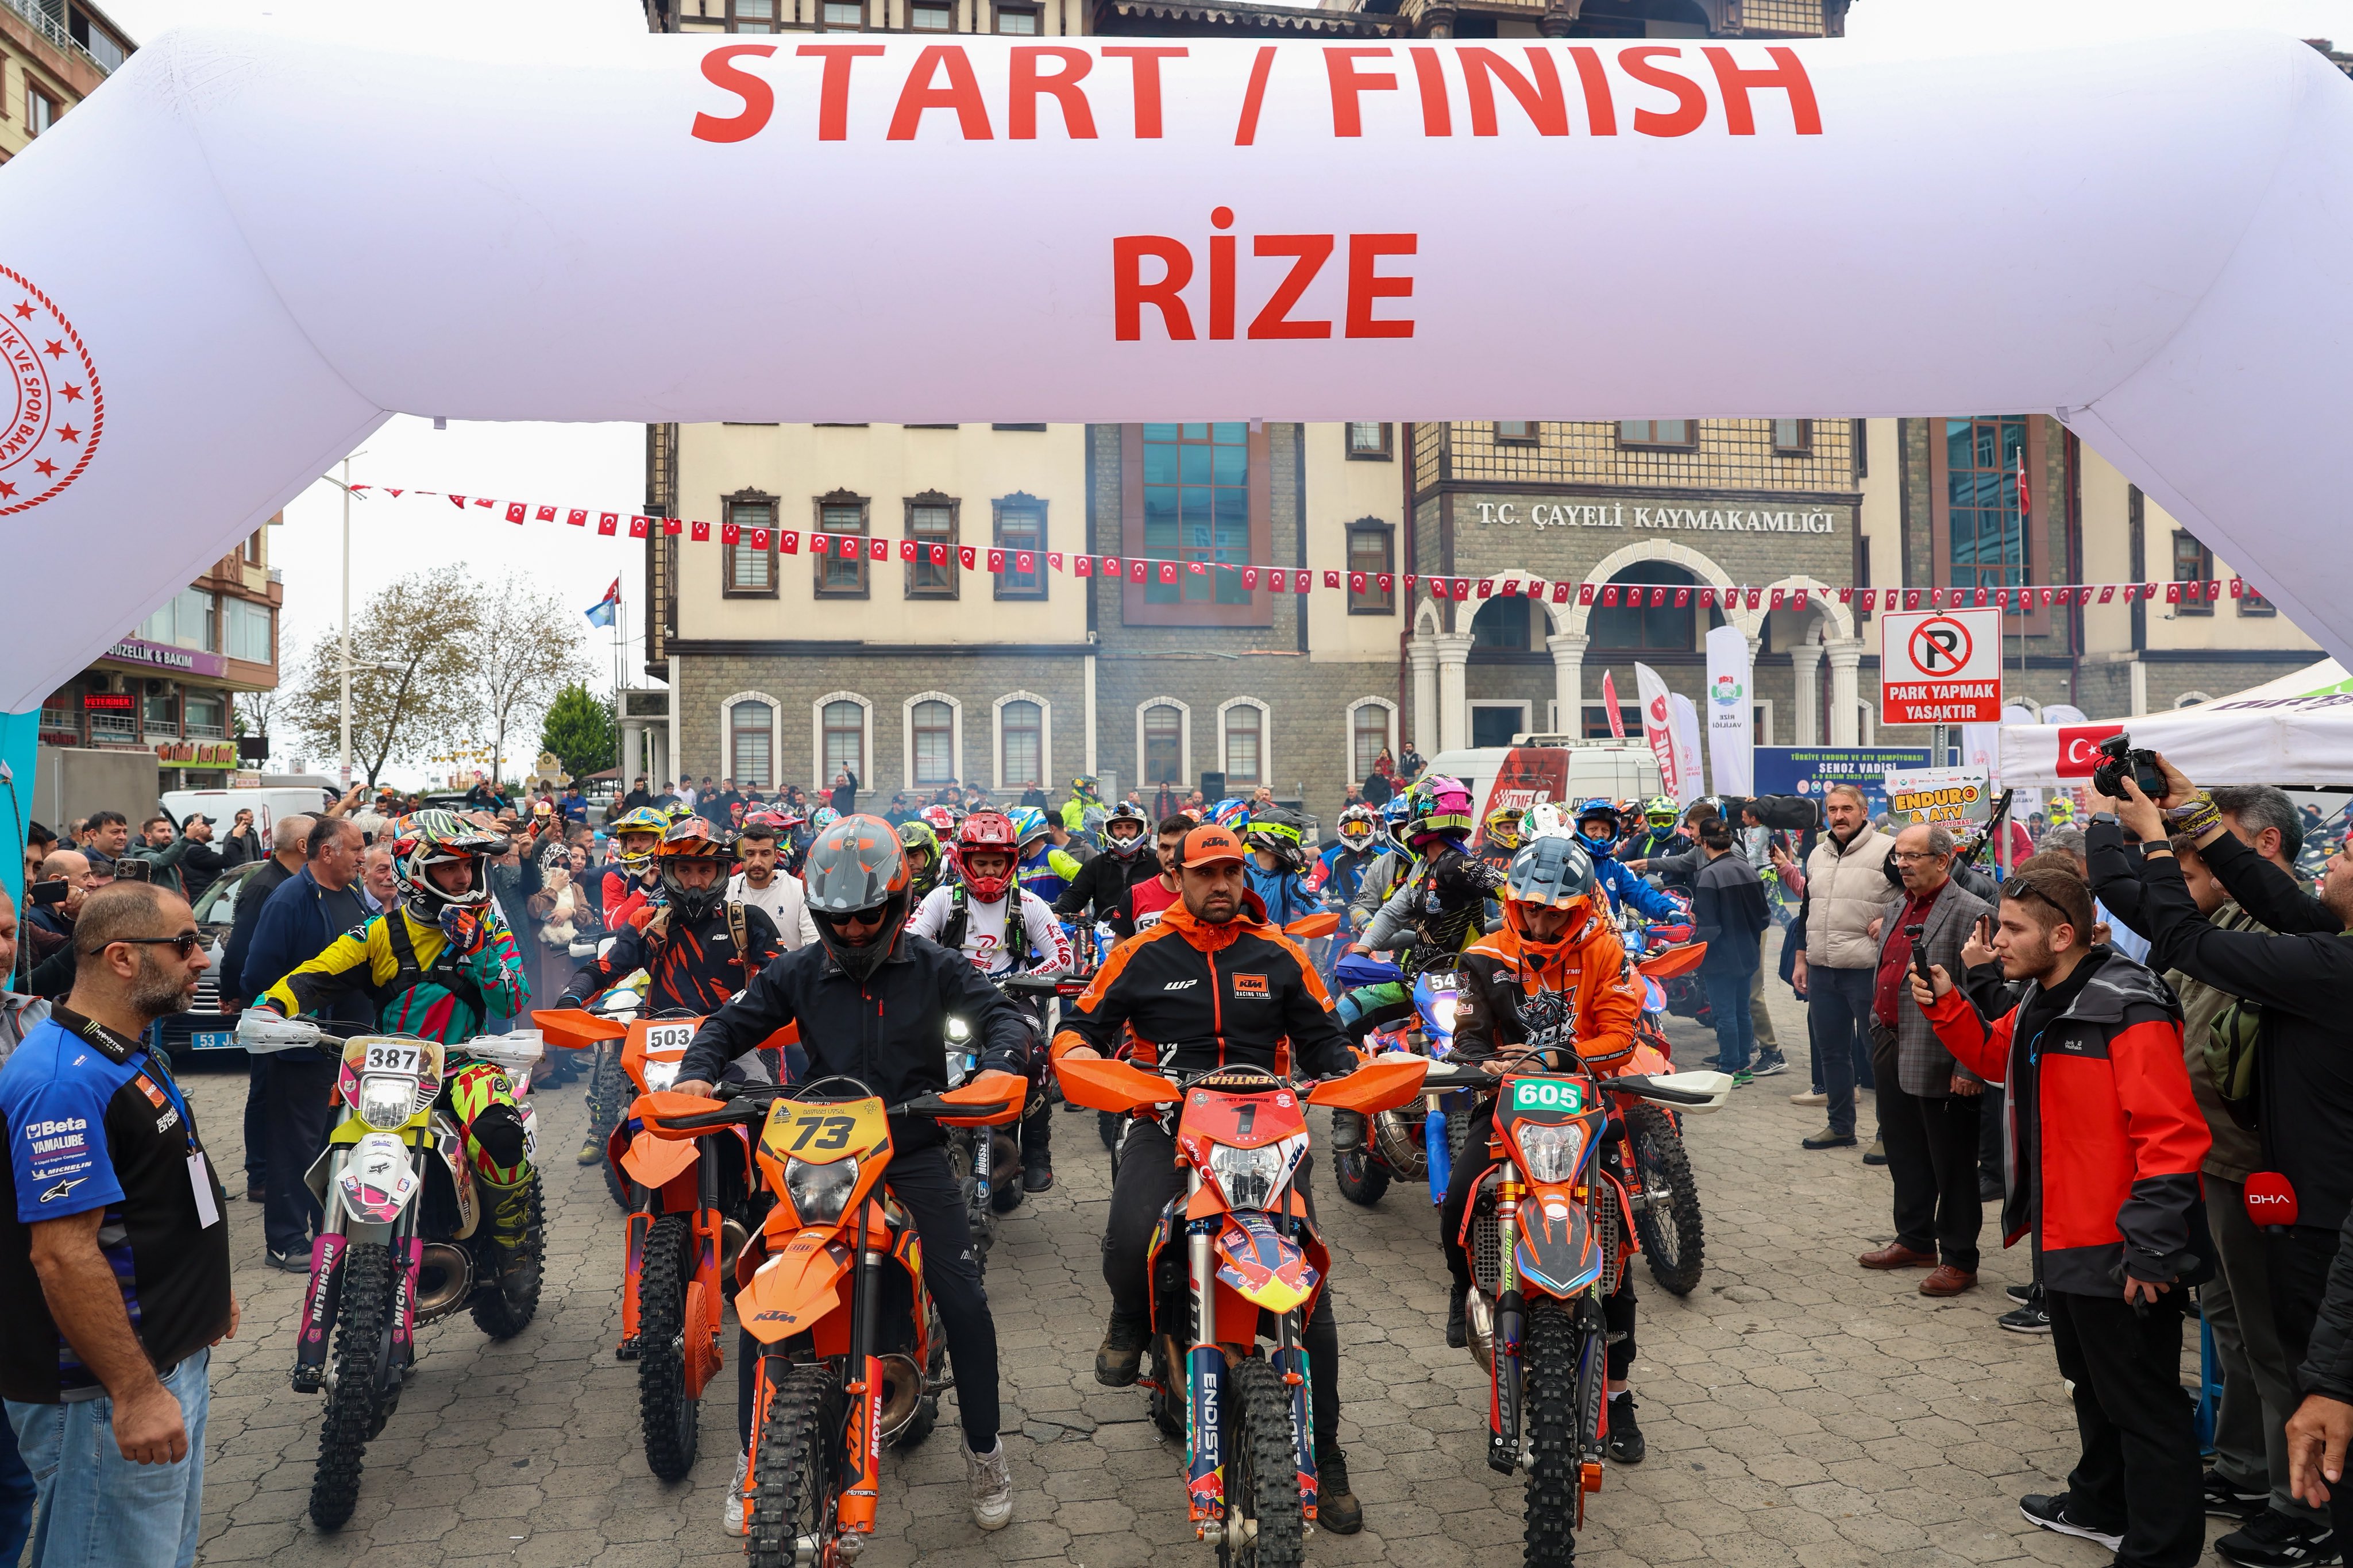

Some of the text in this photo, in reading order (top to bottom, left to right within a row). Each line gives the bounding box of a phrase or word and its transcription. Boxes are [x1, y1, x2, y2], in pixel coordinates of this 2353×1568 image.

[692, 45, 1822, 145] START / FINISH
[1113, 206, 1418, 341] RİZE
[14, 349, 35, 373] VE
[24, 377, 42, 423] SPOR
[1476, 503, 1834, 534] T.C. ÇAYELİ KAYMAKAMLIĞI
[164, 652, 192, 668] BAKIM
[1890, 684, 1995, 700] PARK YAPMAK
[1906, 705, 1976, 720] YASAKTIR
[1791, 753, 1819, 761] TÜRKİYE
[1819, 763, 1854, 773] SENOZ
[1510, 795, 1532, 808] TMF
[1895, 786, 1978, 811] ENDURO
[1929, 805, 1964, 822] ATV
[1201, 837, 1229, 849] KTM
[1270, 827, 1298, 838] LS2
[1239, 979, 1262, 988] KTM
[200, 1034, 215, 1047] 53
[650, 1029, 690, 1048] 503
[368, 1048, 417, 1070] 387
[1518, 1084, 1579, 1109] 605
[42, 1118, 87, 1136] Beta
[1230, 1103, 1257, 1135] 1
[32, 1133, 84, 1154] YAMALUBE
[790, 1116, 856, 1151] 73
[47, 1161, 92, 1175] MICHELIN
[978, 1143, 988, 1176] MOUSSE
[1288, 1143, 1305, 1173] KTM
[312, 1242, 335, 1322] MICHELIN
[752, 1310, 797, 1324] KTM
[1495, 1338, 1513, 1435] DUNLOP
[1586, 1339, 1608, 1437] DUNLOP
[870, 1395, 881, 1459] MOTUL
[1204, 1373, 1218, 1466] ENDIST
[846, 1401, 862, 1474] KTM
